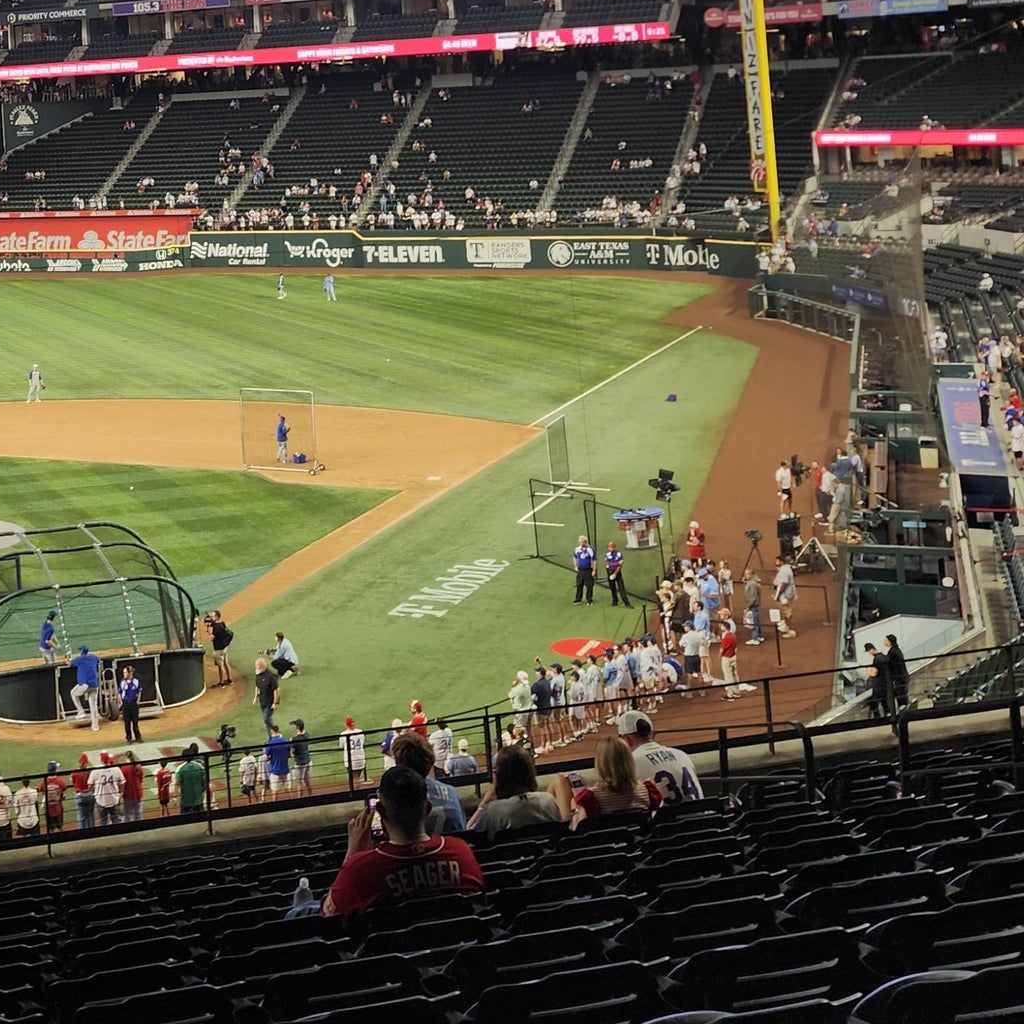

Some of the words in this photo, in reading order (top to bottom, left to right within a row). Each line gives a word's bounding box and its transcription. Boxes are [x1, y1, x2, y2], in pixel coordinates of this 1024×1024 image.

[133, 2, 160, 13] 105.3
[160, 0, 183, 10] THE
[18, 12, 48, 22] PRIORITY
[49, 8, 87, 19] COMMERCE
[745, 32, 757, 69] IZ
[749, 81, 764, 151] FARE
[306, 238, 355, 267] Kroger
[574, 242, 598, 250] EAST
[600, 241, 629, 250] TEXAS
[242, 257, 266, 265] Rental
[589, 250, 614, 258] A&M
[138, 259, 183, 271] HONDA
[387, 558, 510, 618] T-Mobile
[646, 750, 677, 766] RYAN
[101, 775, 114, 786] 34
[654, 766, 699, 800] 34
[434, 784, 453, 802] JR.
[385, 860, 461, 896] SEAGER
